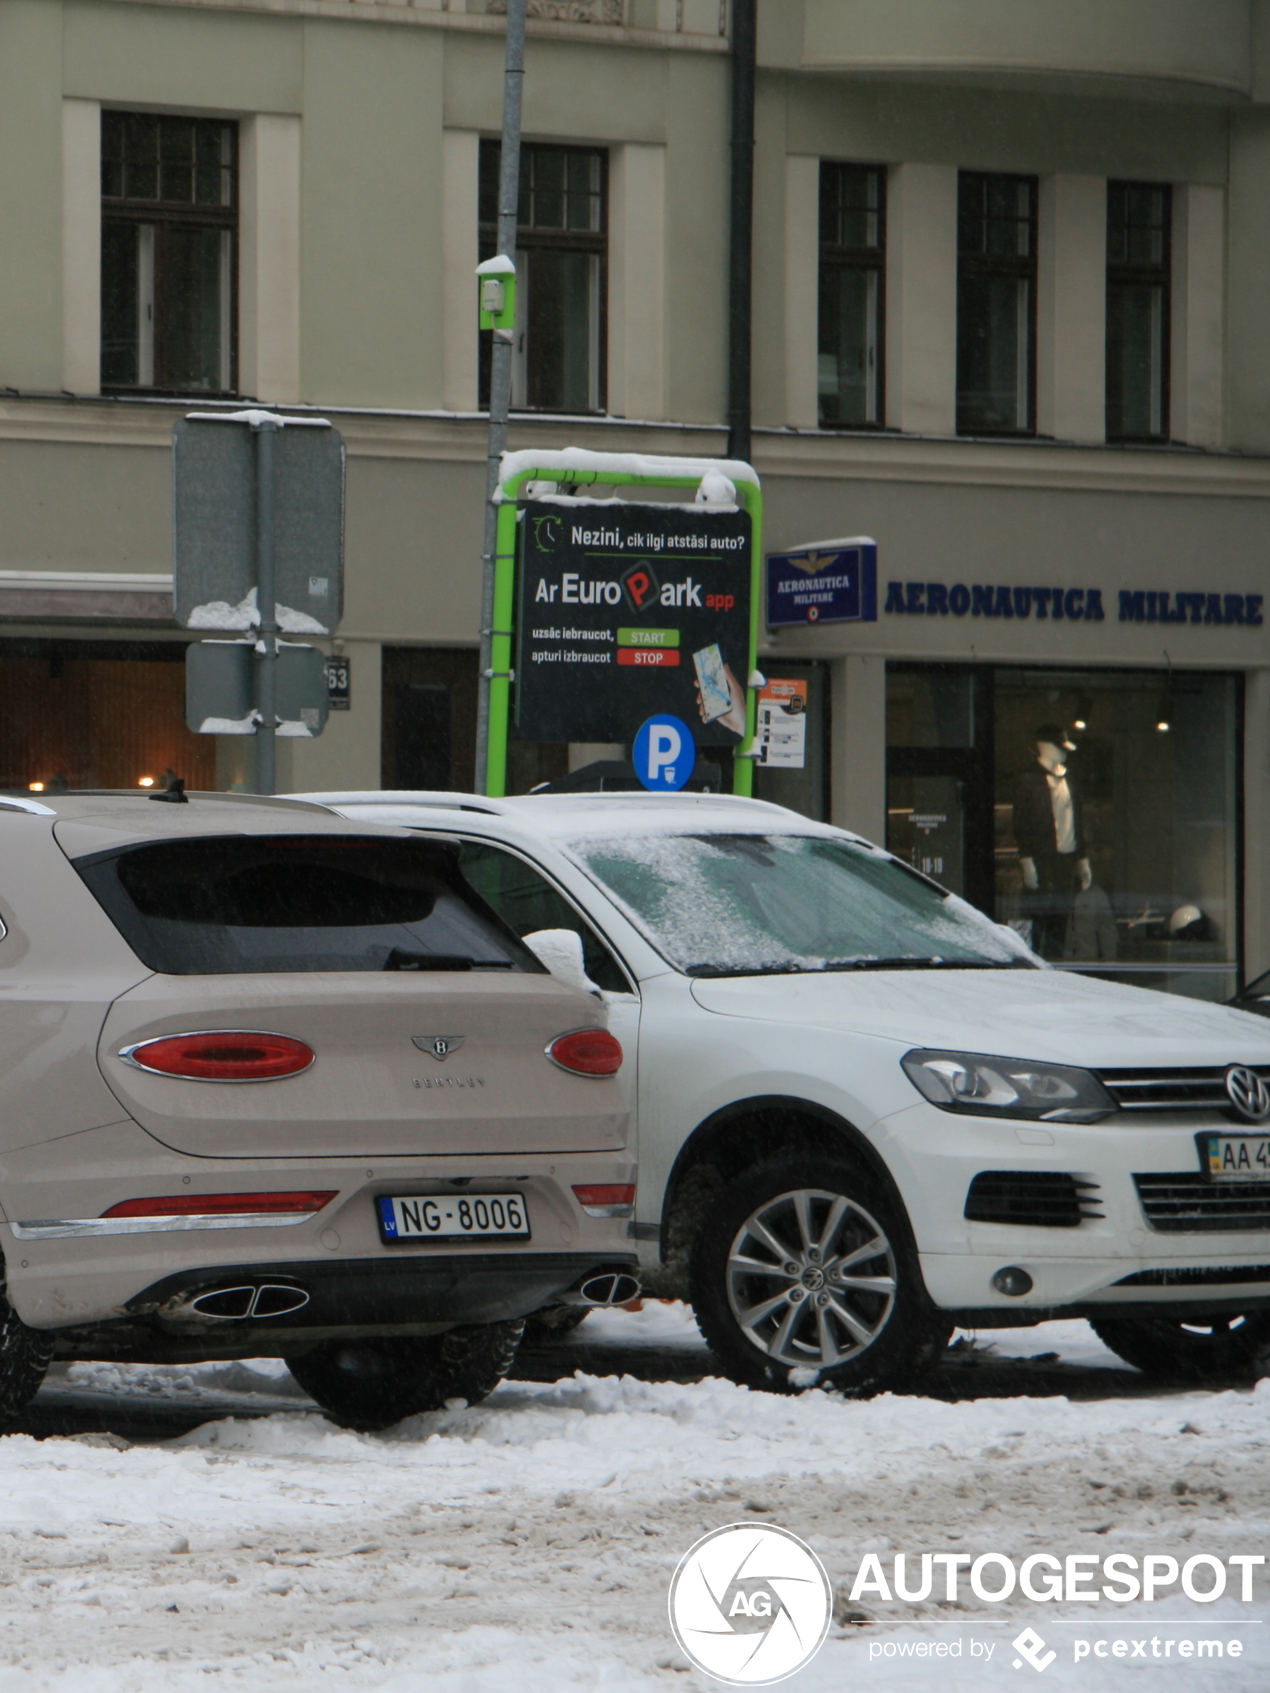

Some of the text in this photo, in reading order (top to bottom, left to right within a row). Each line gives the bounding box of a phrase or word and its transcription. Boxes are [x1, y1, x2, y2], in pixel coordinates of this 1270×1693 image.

[571, 526, 745, 551] Nezini, cik ilgi atstāsi auto?
[535, 578, 558, 603] Ar
[706, 593, 735, 611] app
[777, 575, 850, 593] AERONAUTICA
[793, 592, 834, 605] MILITARE
[884, 581, 1264, 625] AERONAUTICA MILITARE
[532, 627, 666, 644] uzsāc iebraucot, START
[532, 650, 664, 664] apturi izbraucot STOP
[648, 724, 681, 779] P
[412, 1077, 486, 1089] BENTLEY
[1223, 1142, 1251, 1170] AA
[384, 1198, 523, 1233] LV NG-8006
